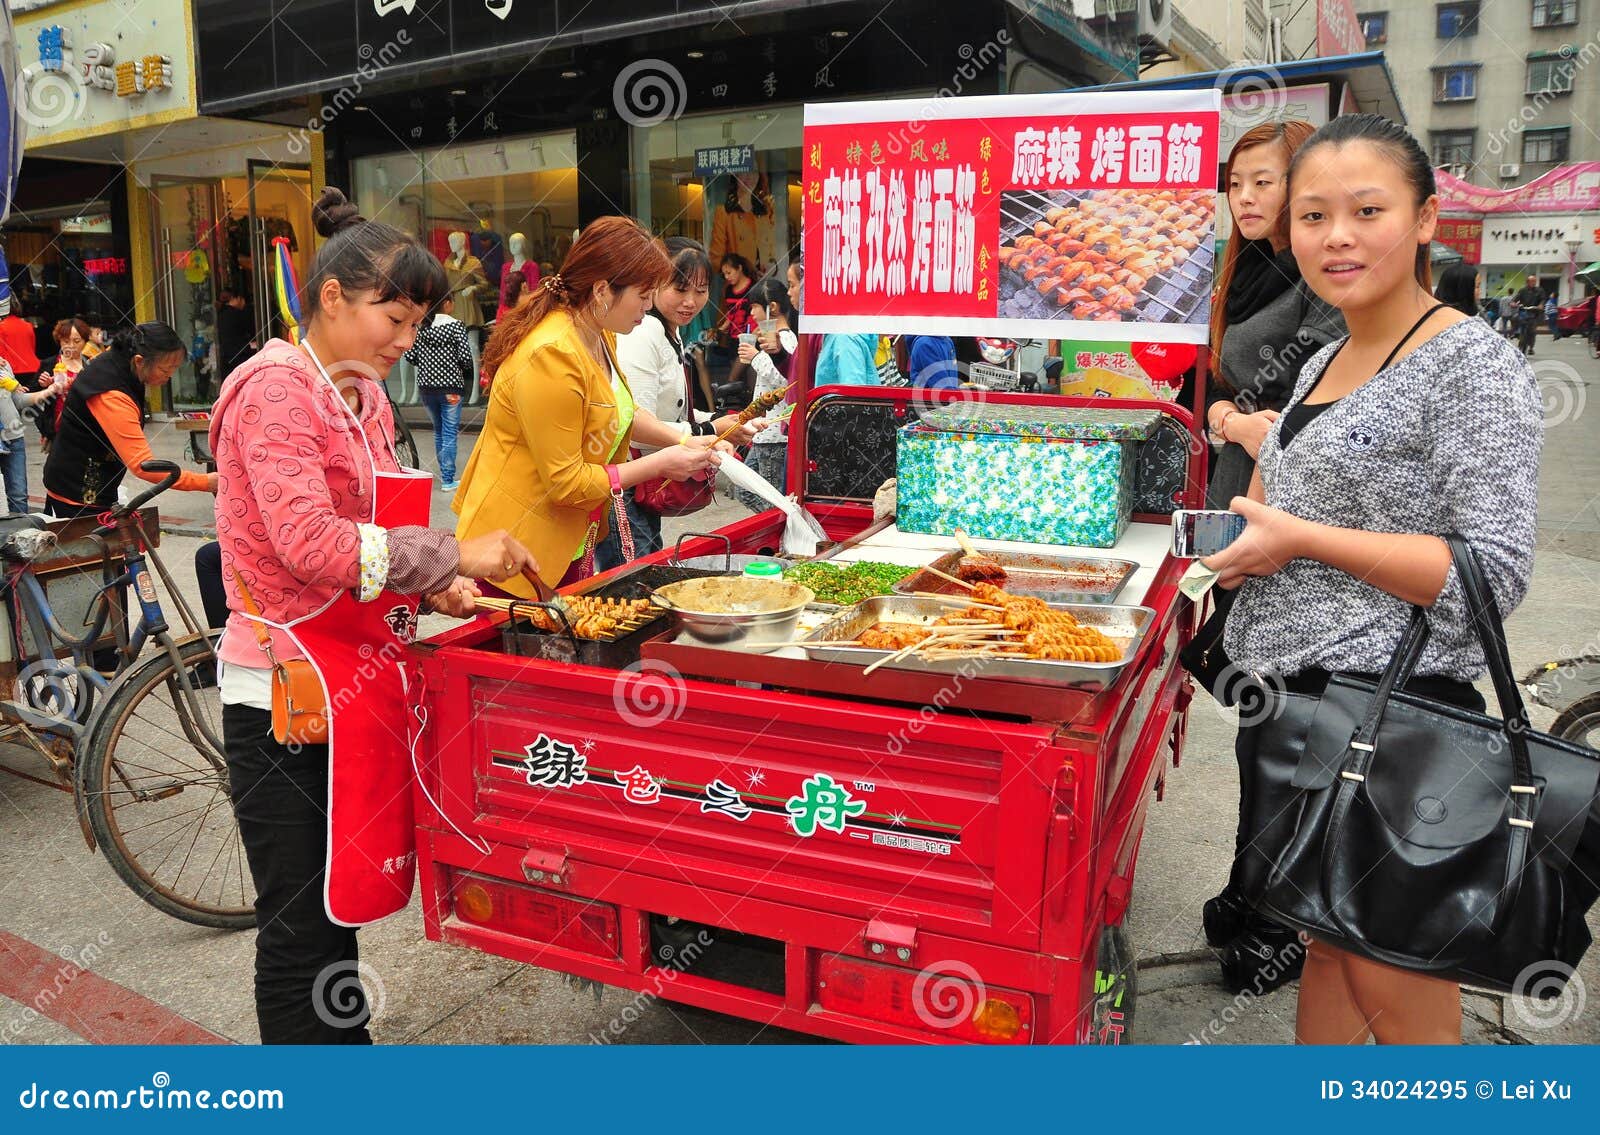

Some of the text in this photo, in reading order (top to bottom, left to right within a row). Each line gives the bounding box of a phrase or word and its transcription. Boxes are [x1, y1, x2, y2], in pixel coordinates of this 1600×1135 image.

[711, 65, 835, 98] 四季风
[698, 146, 751, 168] 联网报警户
[808, 142, 823, 204] 刘记
[846, 138, 950, 165] 特色 风味
[1011, 126, 1082, 186] 麻辣
[1089, 122, 1203, 184] 烤面筋
[822, 163, 977, 297] 麻辣 孜然 烤面筋
[976, 136, 992, 301] 绿色 食品
